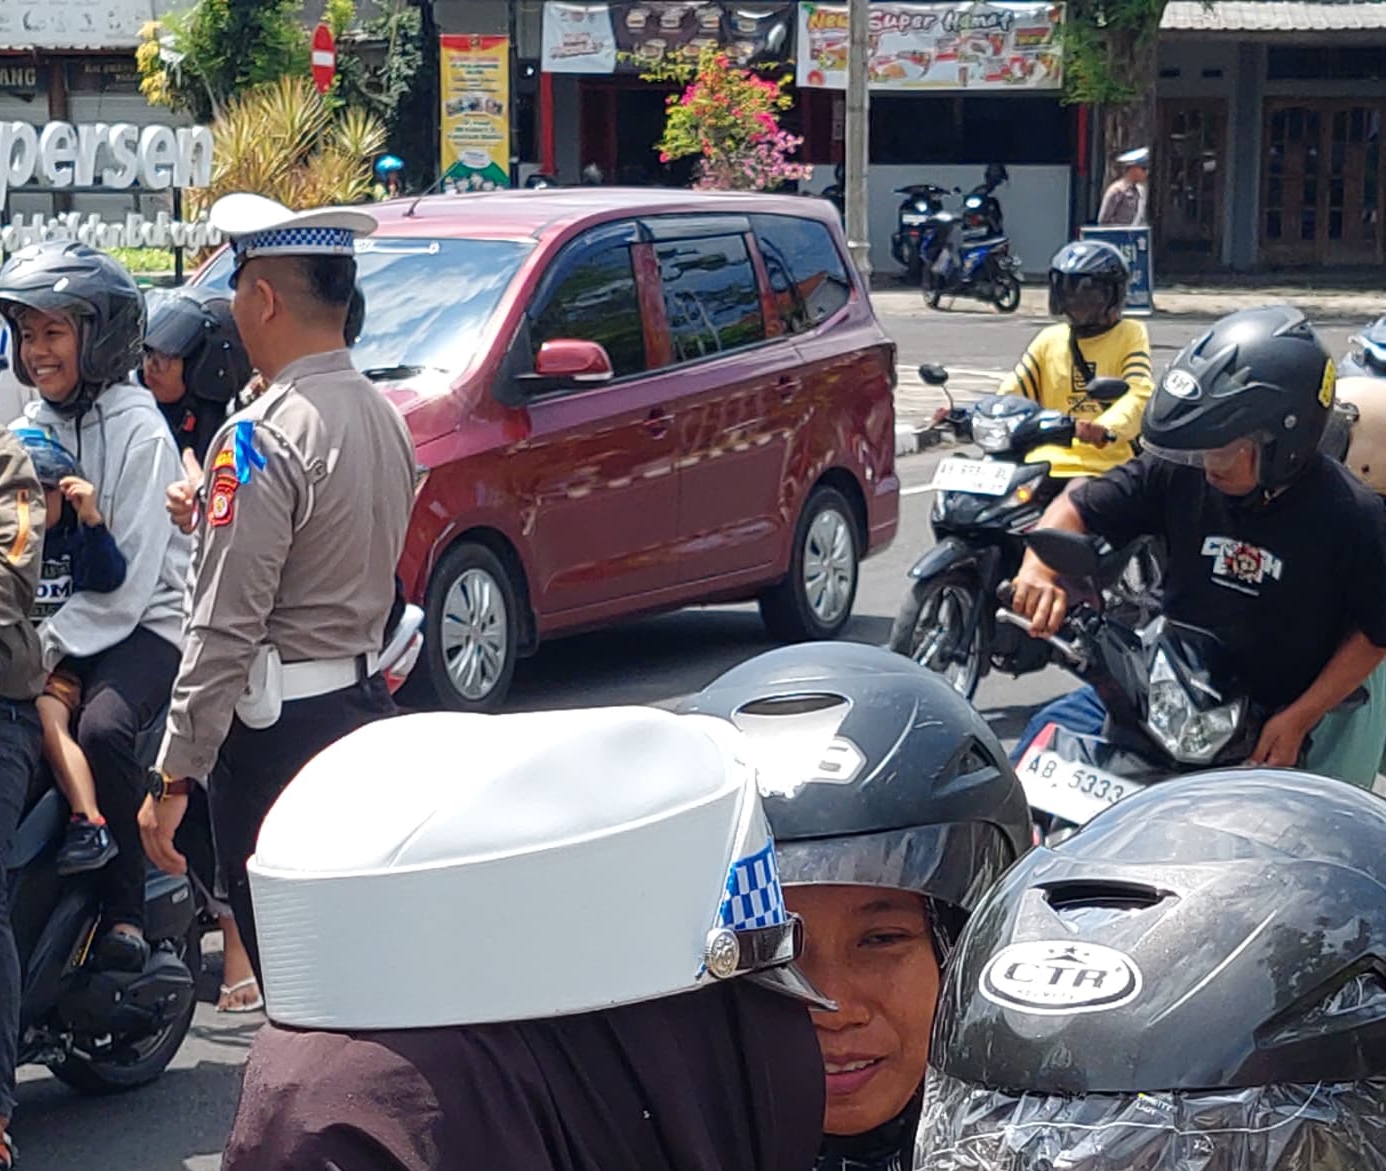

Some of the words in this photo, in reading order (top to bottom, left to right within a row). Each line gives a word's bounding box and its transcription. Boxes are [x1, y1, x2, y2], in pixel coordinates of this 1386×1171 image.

[1026, 753, 1058, 779] AB
[1068, 769, 1125, 805] 5333
[1004, 962, 1108, 989] CTR
